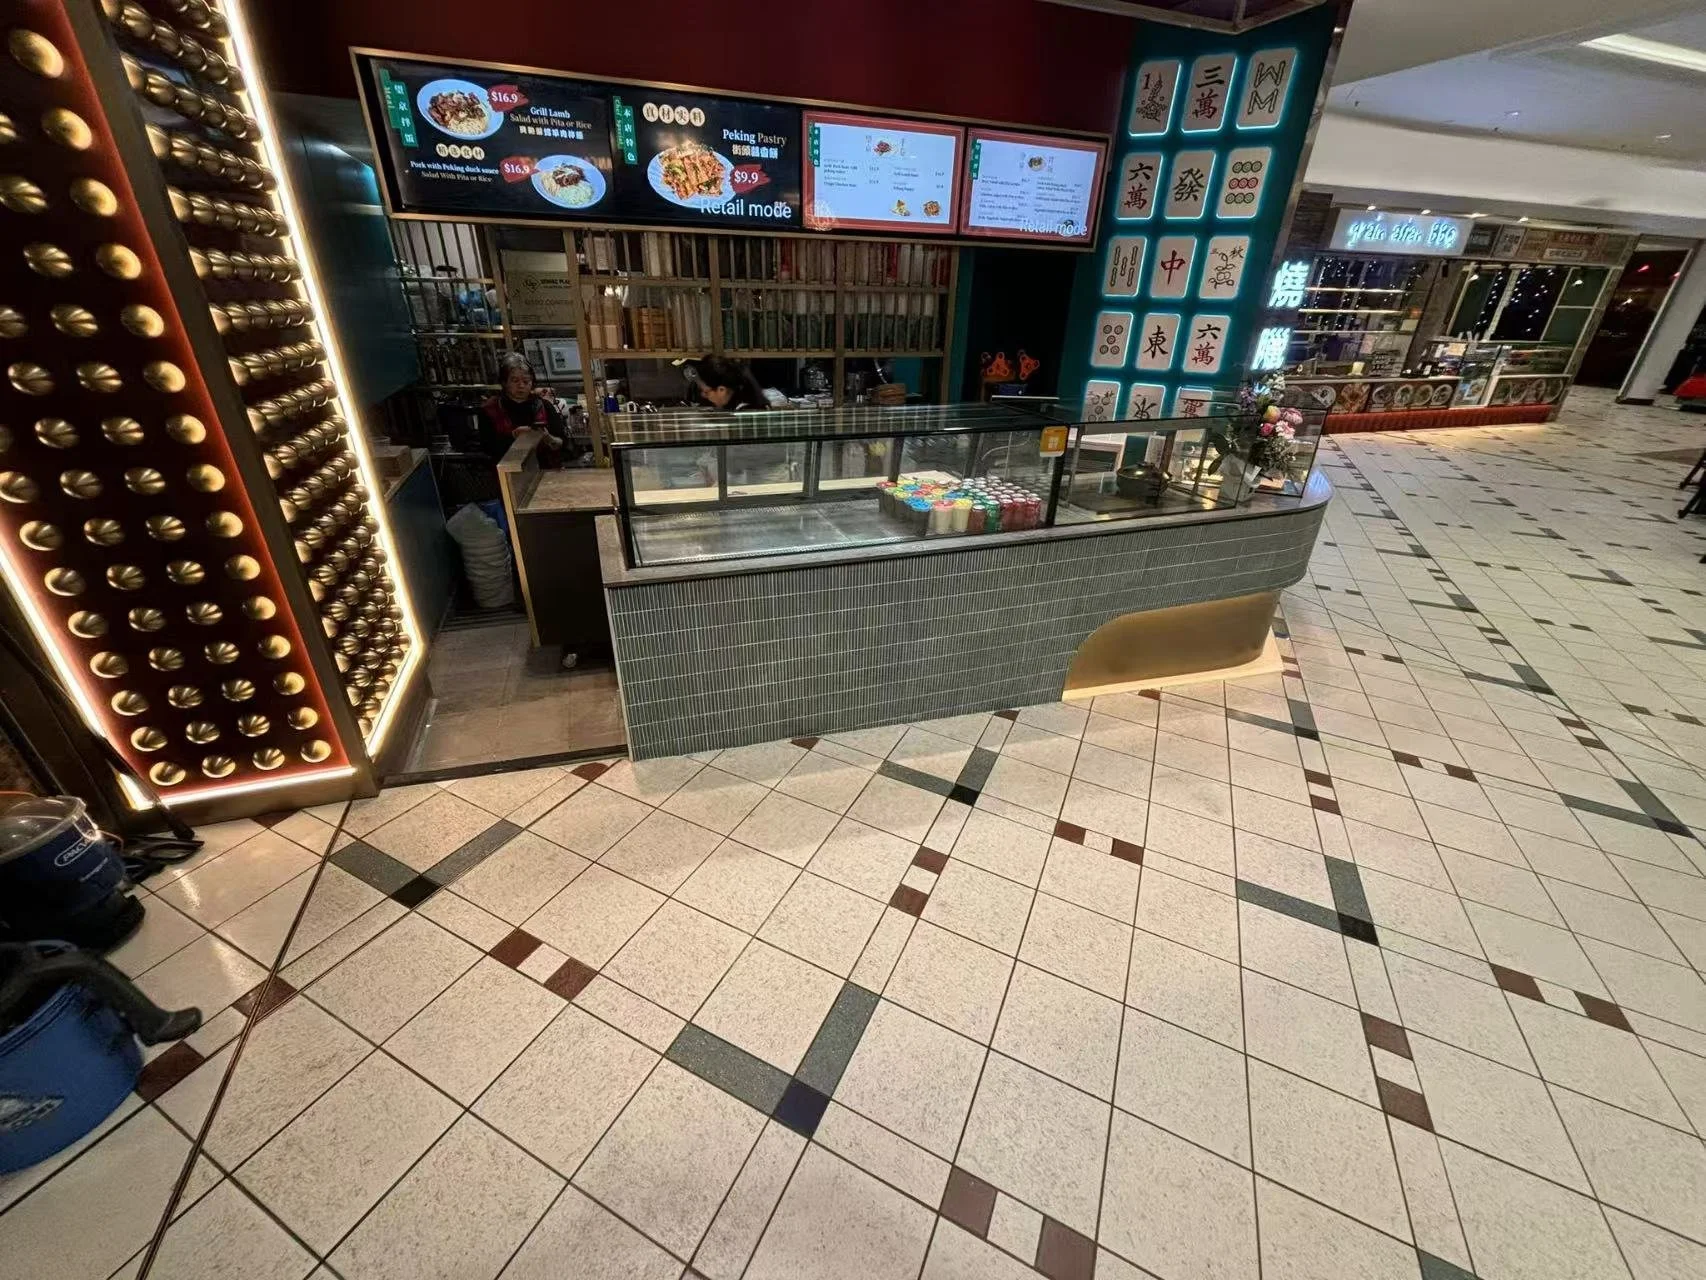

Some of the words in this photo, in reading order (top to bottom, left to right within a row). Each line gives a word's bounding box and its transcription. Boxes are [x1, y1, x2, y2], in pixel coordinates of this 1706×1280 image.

[1142, 73, 1150, 90] 1
[491, 91, 519, 104] $16.9
[1192, 66, 1225, 119] 三萬
[510, 113, 531, 123] Salad
[532, 116, 549, 125] with
[550, 117, 565, 127] Pita
[566, 120, 575, 128] or
[576, 120, 592, 129] Rice
[530, 106, 548, 116] Grill
[549, 108, 571, 119] Lamb
[723, 128, 756, 144] Peking
[757, 132, 787, 147] Pastry
[410, 160, 426, 169] Pork
[427, 162, 442, 170] with
[443, 163, 465, 174] Peking
[503, 163, 530, 175] $16.9
[734, 170, 759, 185] $9.9
[1125, 162, 1153, 209] 六萬
[1173, 167, 1205, 203] 發
[700, 197, 744, 216] Retail
[749, 199, 792, 219] mode
[1160, 249, 1186, 285] 中
[1143, 326, 1168, 360] 東
[1192, 324, 1221, 366] 六萬
